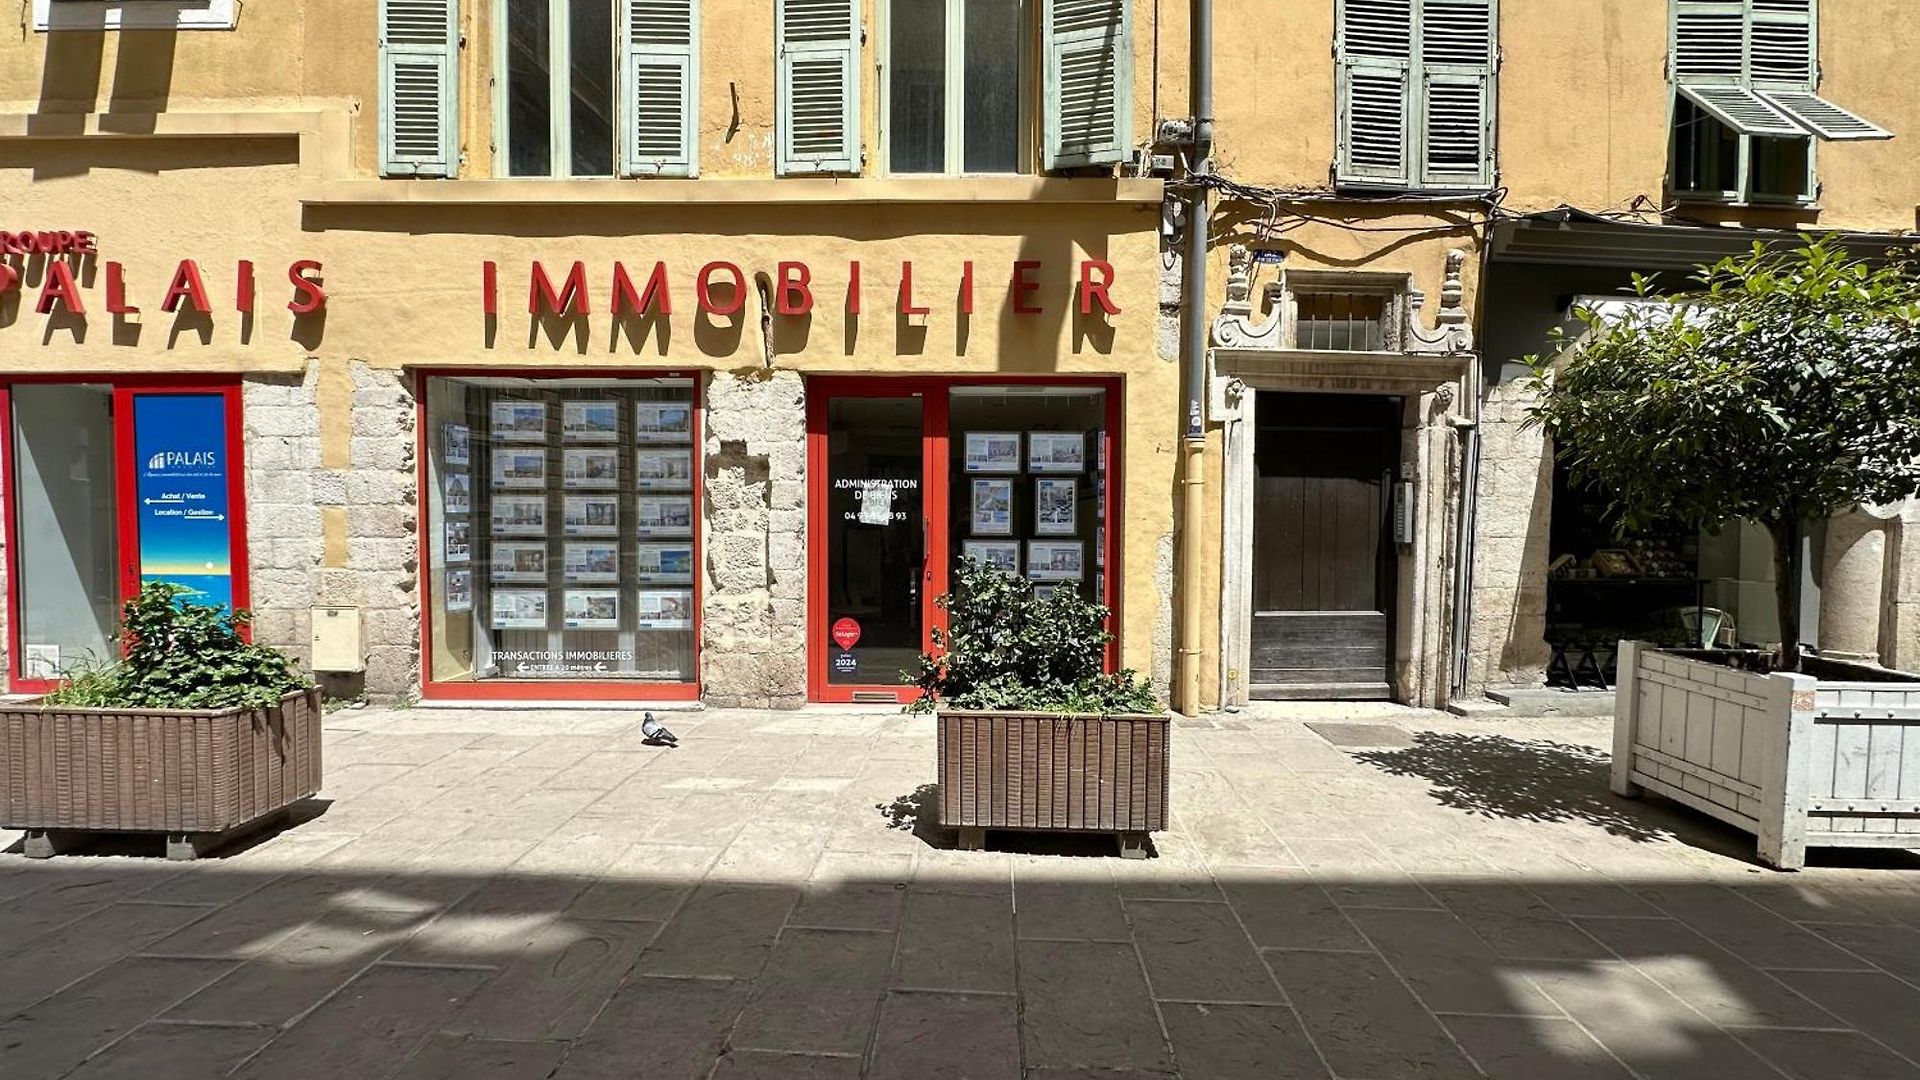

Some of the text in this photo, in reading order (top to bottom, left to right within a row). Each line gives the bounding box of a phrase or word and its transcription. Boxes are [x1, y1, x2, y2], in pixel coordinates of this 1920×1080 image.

[484, 260, 1122, 315] IMMOBILIER
[167, 452, 216, 465] PALAIS
[835, 479, 917, 488] ADMINISTRATION
[844, 511, 856, 520] 04
[895, 511, 907, 520] 93
[491, 651, 563, 661] TRANSACTIONS
